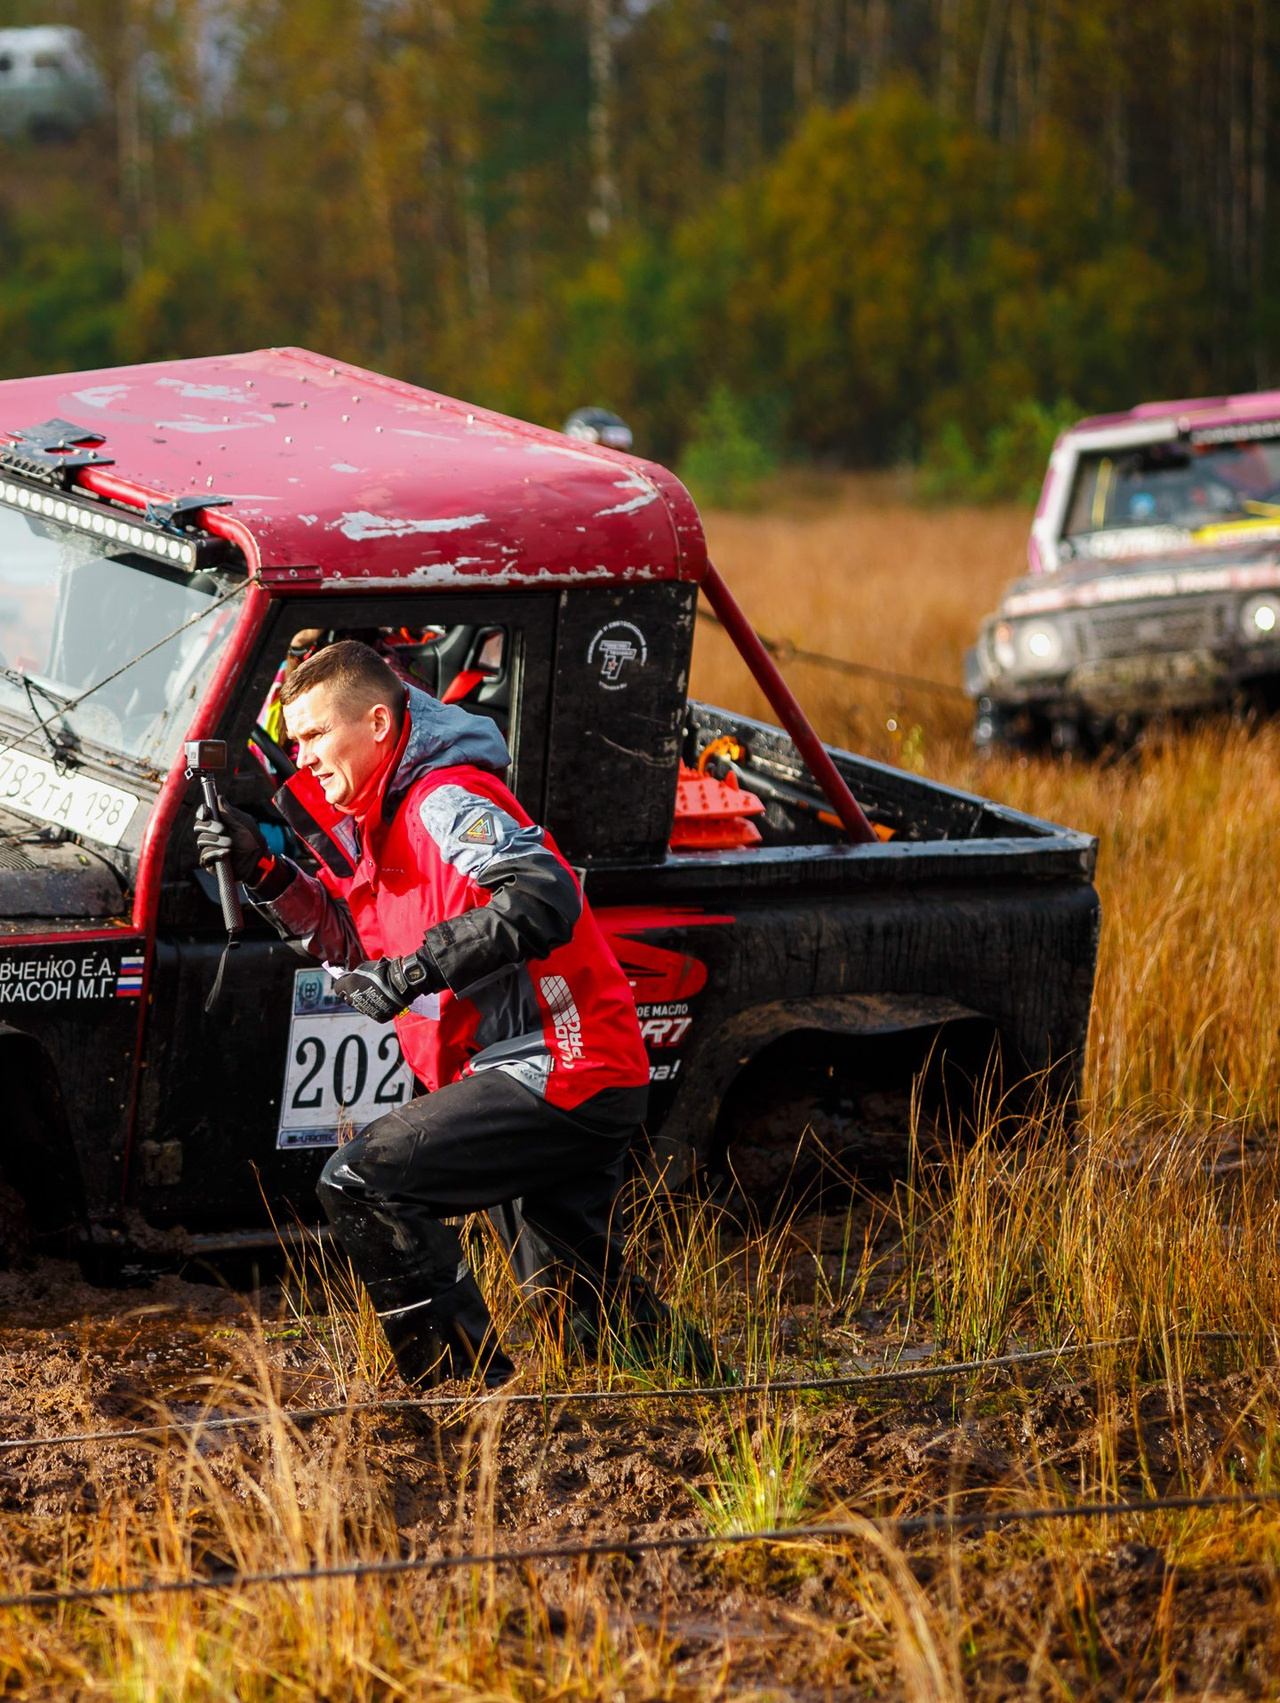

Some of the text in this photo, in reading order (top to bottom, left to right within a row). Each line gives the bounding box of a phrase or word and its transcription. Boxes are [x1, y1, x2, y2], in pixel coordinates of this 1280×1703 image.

[85, 791, 124, 826] 198
[81, 957, 116, 978] Е.А.
[76, 977, 114, 999] М.Г.
[652, 1003, 688, 1017] МАСЛО
[291, 1031, 406, 1110] 202
